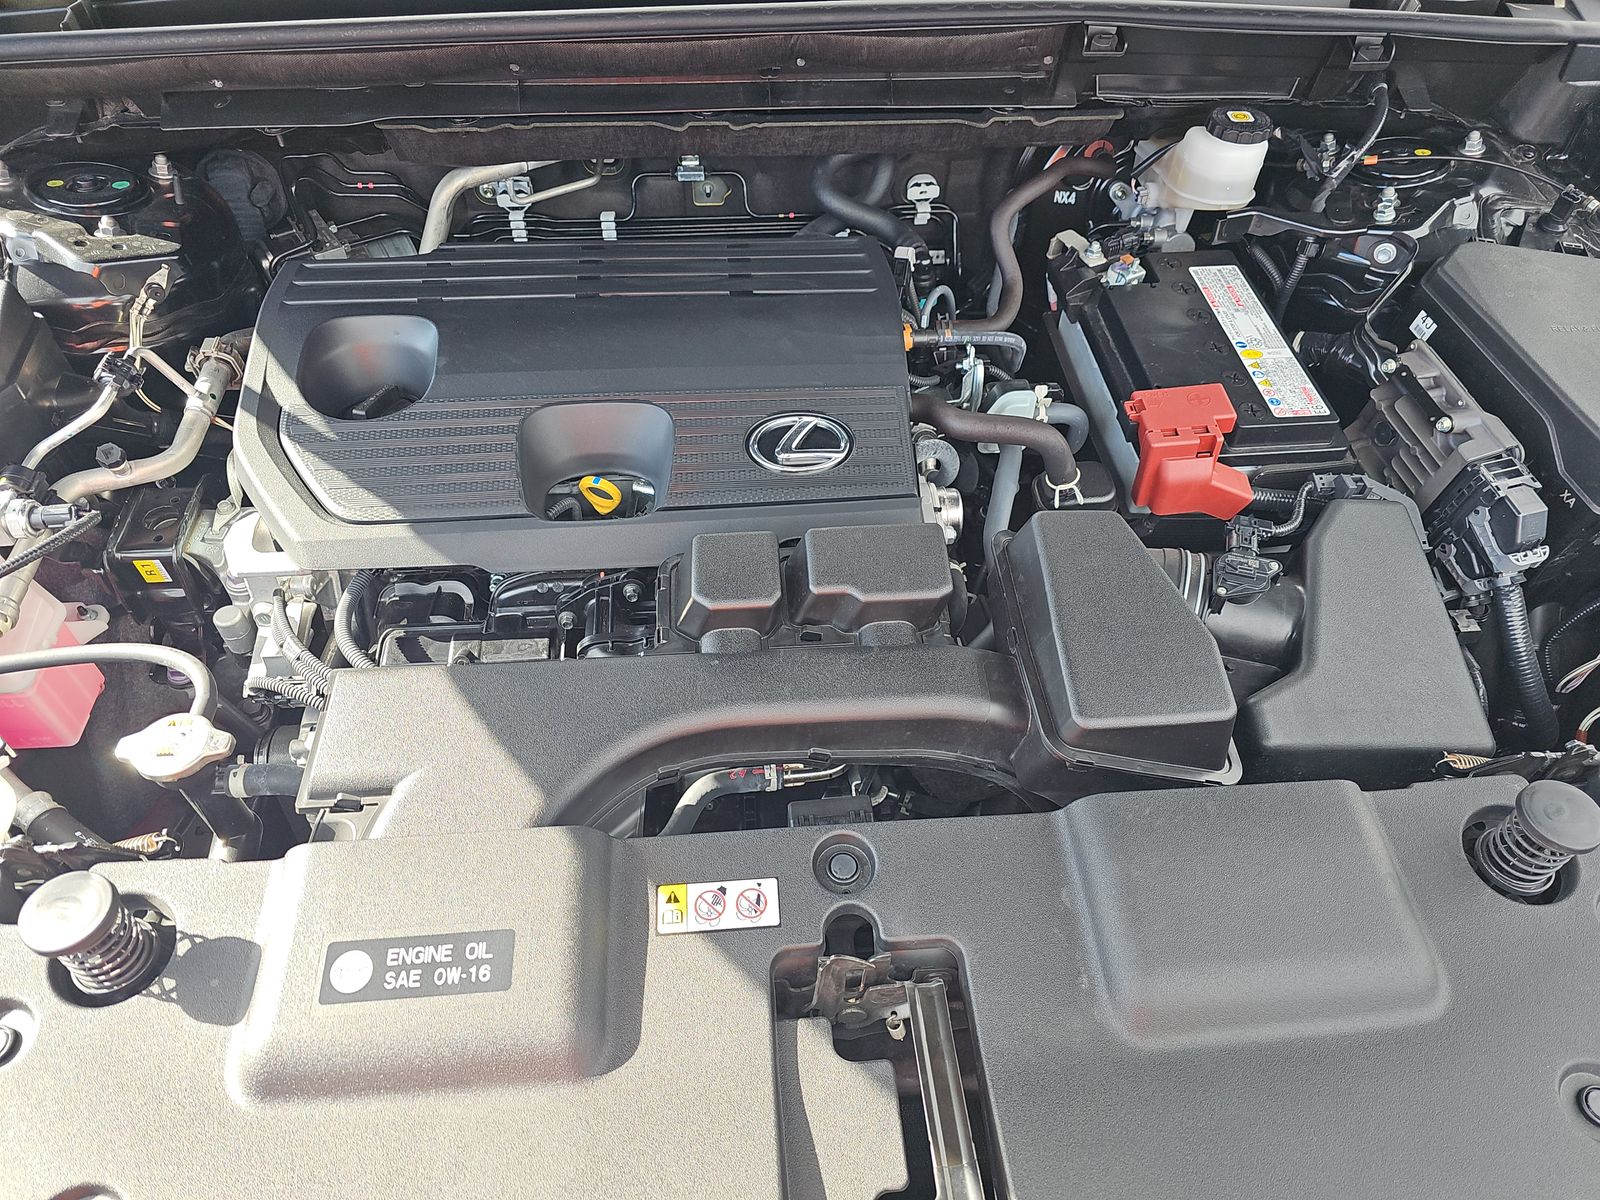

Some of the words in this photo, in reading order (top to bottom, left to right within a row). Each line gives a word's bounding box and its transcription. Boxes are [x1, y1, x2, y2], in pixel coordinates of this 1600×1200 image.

[1053, 190, 1077, 205] NX4
[1421, 315, 1435, 330] 4J
[386, 944, 453, 966] ENGINE
[465, 942, 493, 960] OIL
[383, 969, 422, 990] SAE
[434, 964, 492, 986] 0W-16
